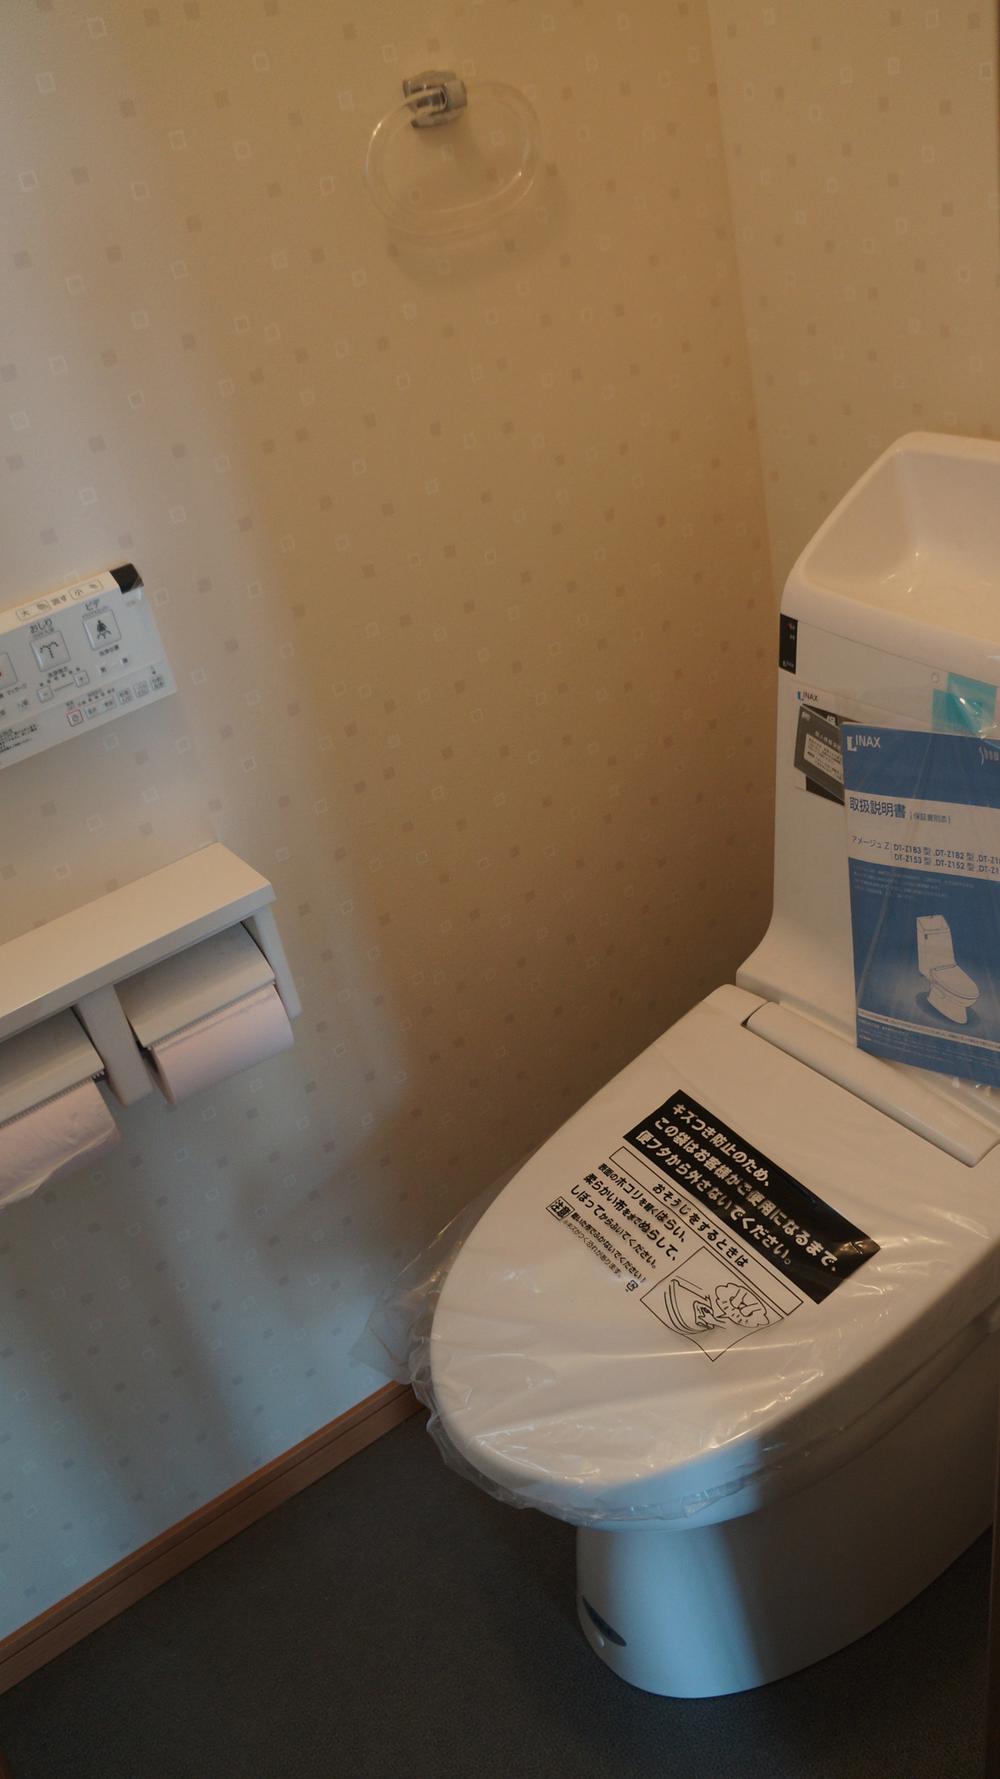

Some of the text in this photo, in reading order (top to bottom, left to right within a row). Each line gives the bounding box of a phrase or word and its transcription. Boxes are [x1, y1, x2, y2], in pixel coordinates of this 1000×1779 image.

[849, 796, 906, 819] 取扱説明書
[672, 1102, 770, 1187] キズつき防止のため、
[635, 1129, 792, 1266] 便フタから外さないでください。
[652, 1183, 749, 1268] おそうじをするときは
[654, 1116, 838, 1272] この袋はお客様がご使用になるまで、
